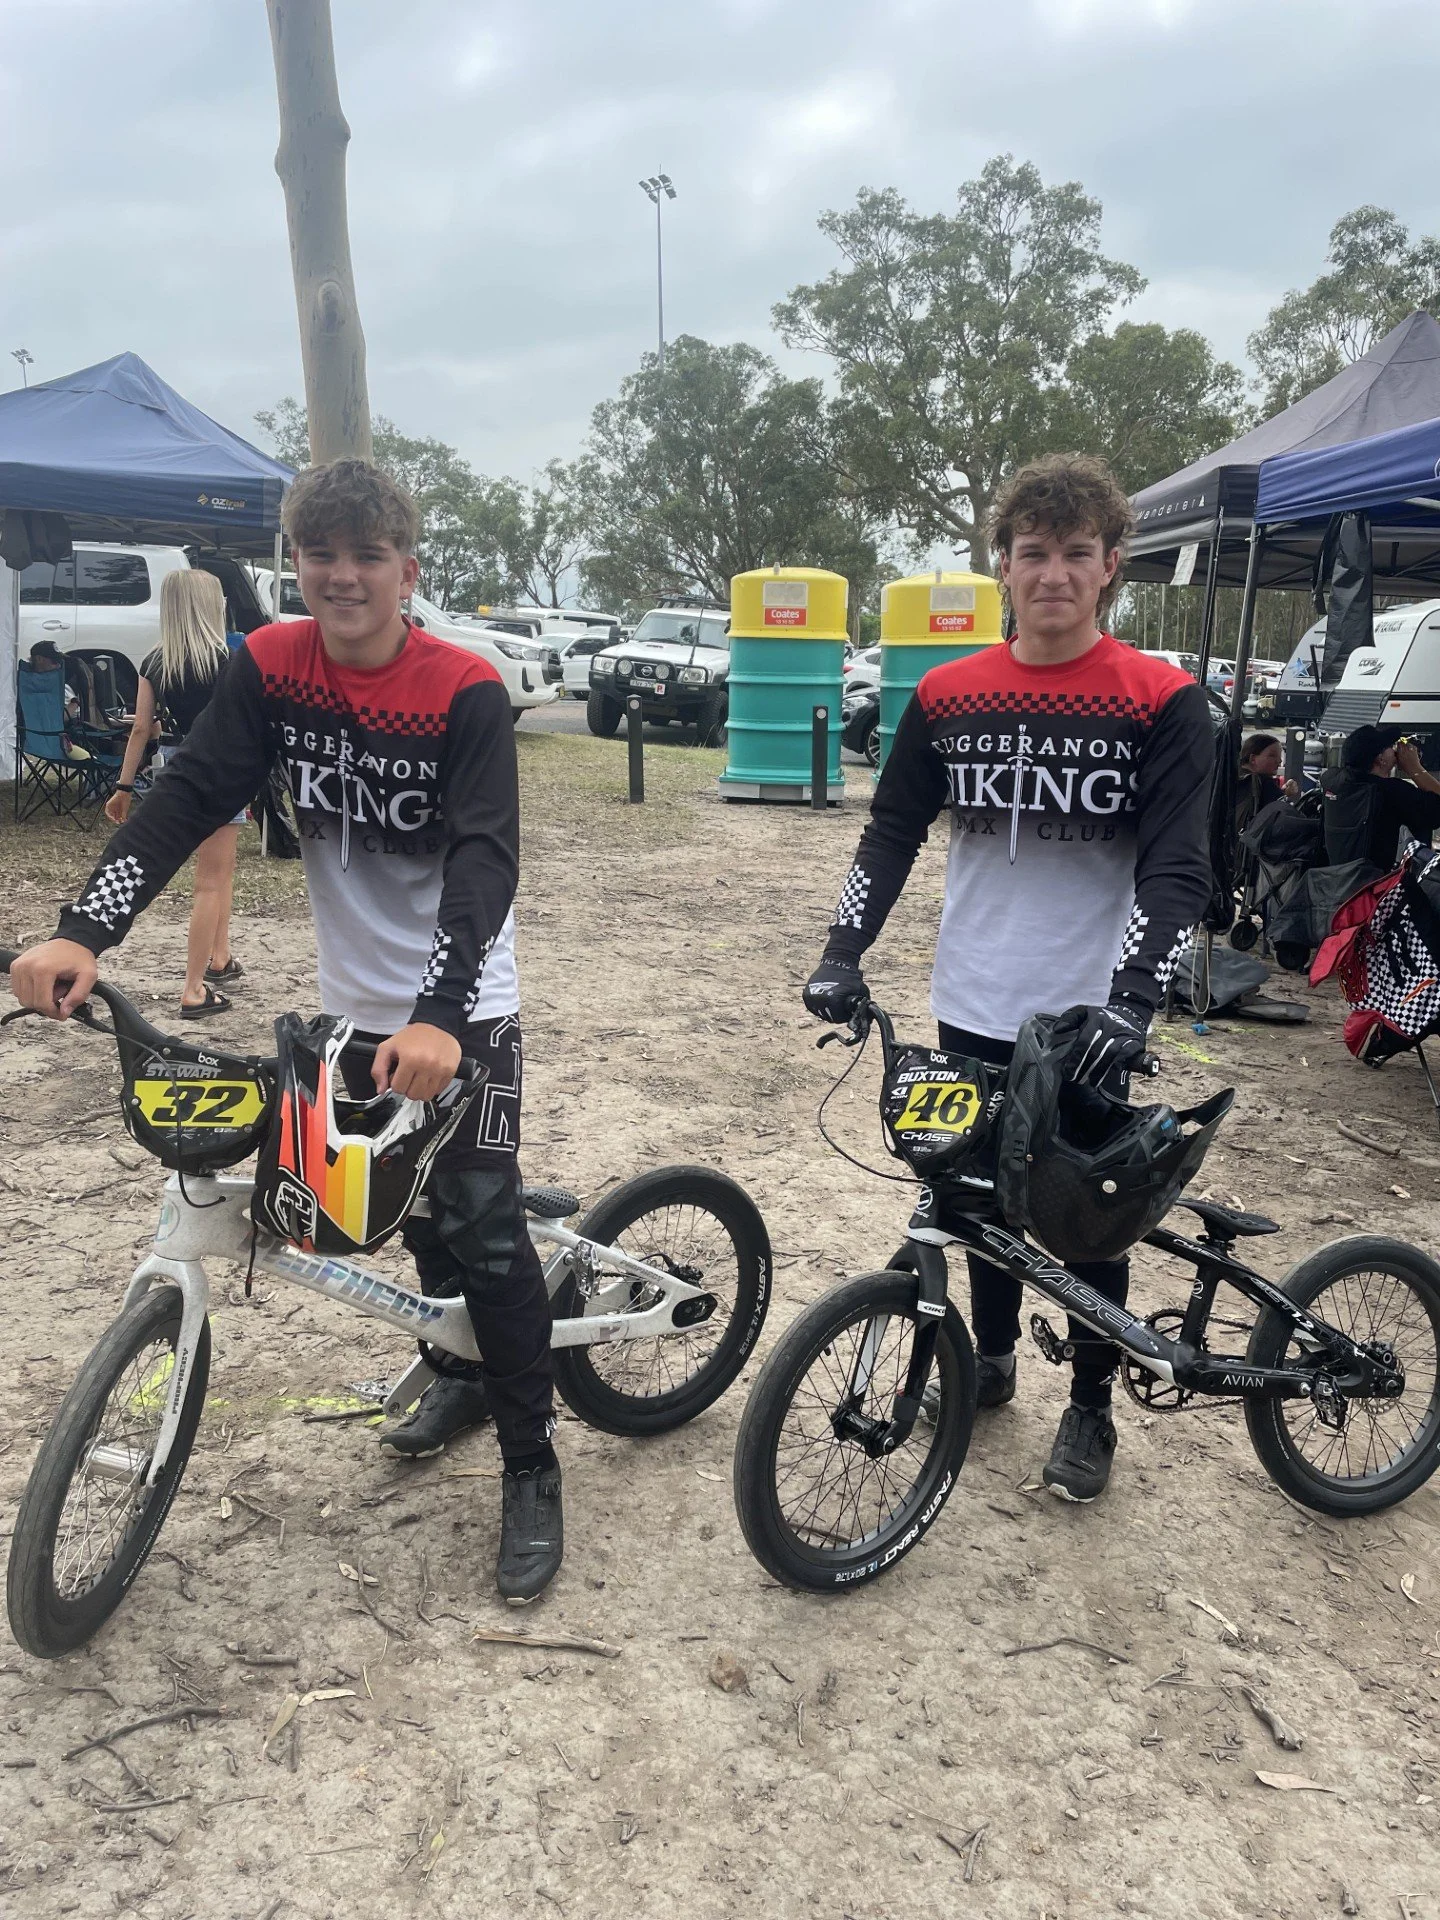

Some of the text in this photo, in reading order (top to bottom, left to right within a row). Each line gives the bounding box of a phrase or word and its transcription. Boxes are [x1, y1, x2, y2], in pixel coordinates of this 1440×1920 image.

[771, 609, 800, 619] Coates
[936, 616, 968, 626] Coates
[271, 721, 438, 780] GGERANON
[931, 733, 1142, 761] TUGGERANON
[287, 757, 445, 831] KING
[1037, 822, 1118, 842] CLUB
[362, 833, 441, 856] CLUB
[198, 1052, 220, 1067] box
[930, 1050, 949, 1064] box
[145, 1063, 223, 1079] STEWART
[897, 1070, 960, 1083] BUXTON
[151, 1085, 248, 1124] 32
[909, 1087, 973, 1125] 46
[901, 1131, 954, 1142] CHASE
[757, 1255, 766, 1301] FASTR
[981, 1223, 1136, 1332] CHASE
[1221, 1374, 1264, 1388] AVIAN
[879, 1470, 952, 1567] FASTR REACT
